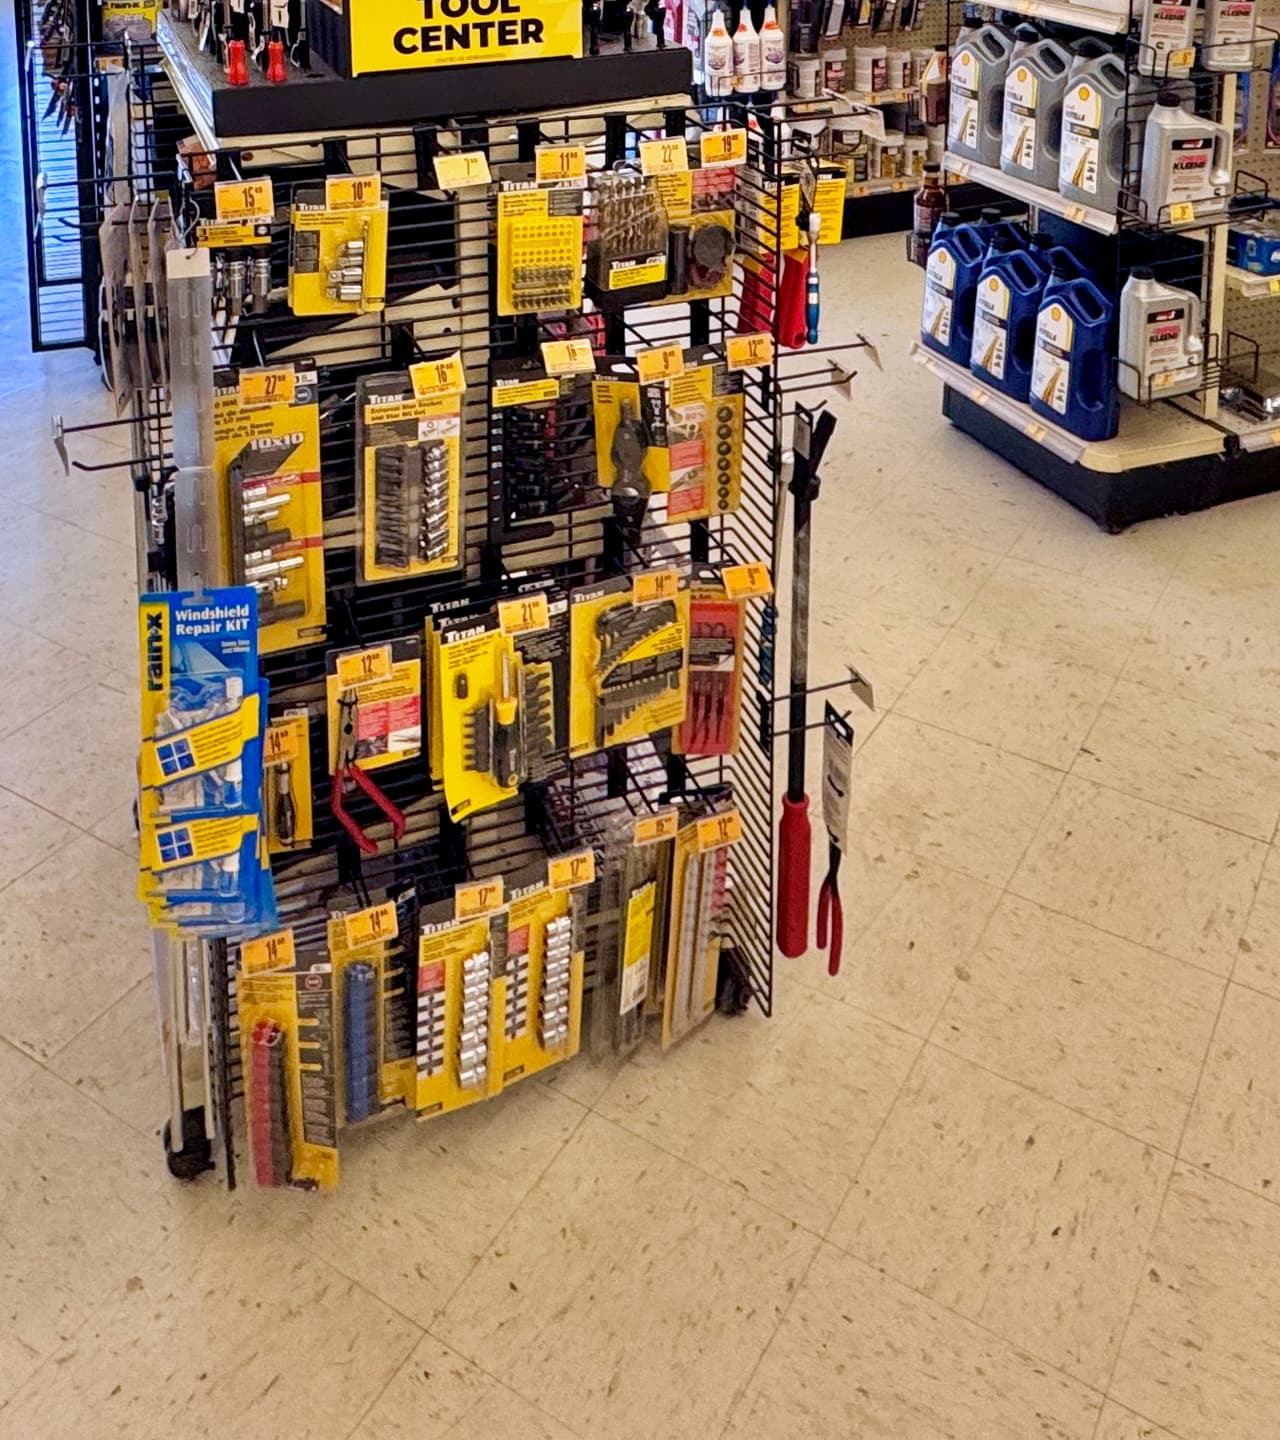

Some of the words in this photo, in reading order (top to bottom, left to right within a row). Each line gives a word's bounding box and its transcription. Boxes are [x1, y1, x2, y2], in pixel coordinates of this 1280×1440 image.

[393, 18, 545, 55] CENTER
[368, 394, 403, 404] TITAN
[251, 432, 305, 450] 10x10
[175, 603, 250, 622] Windshield
[430, 598, 470, 613] TITAN
[176, 621, 223, 636] Repair
[225, 618, 250, 633] KIT
[445, 625, 486, 643] TITAN
